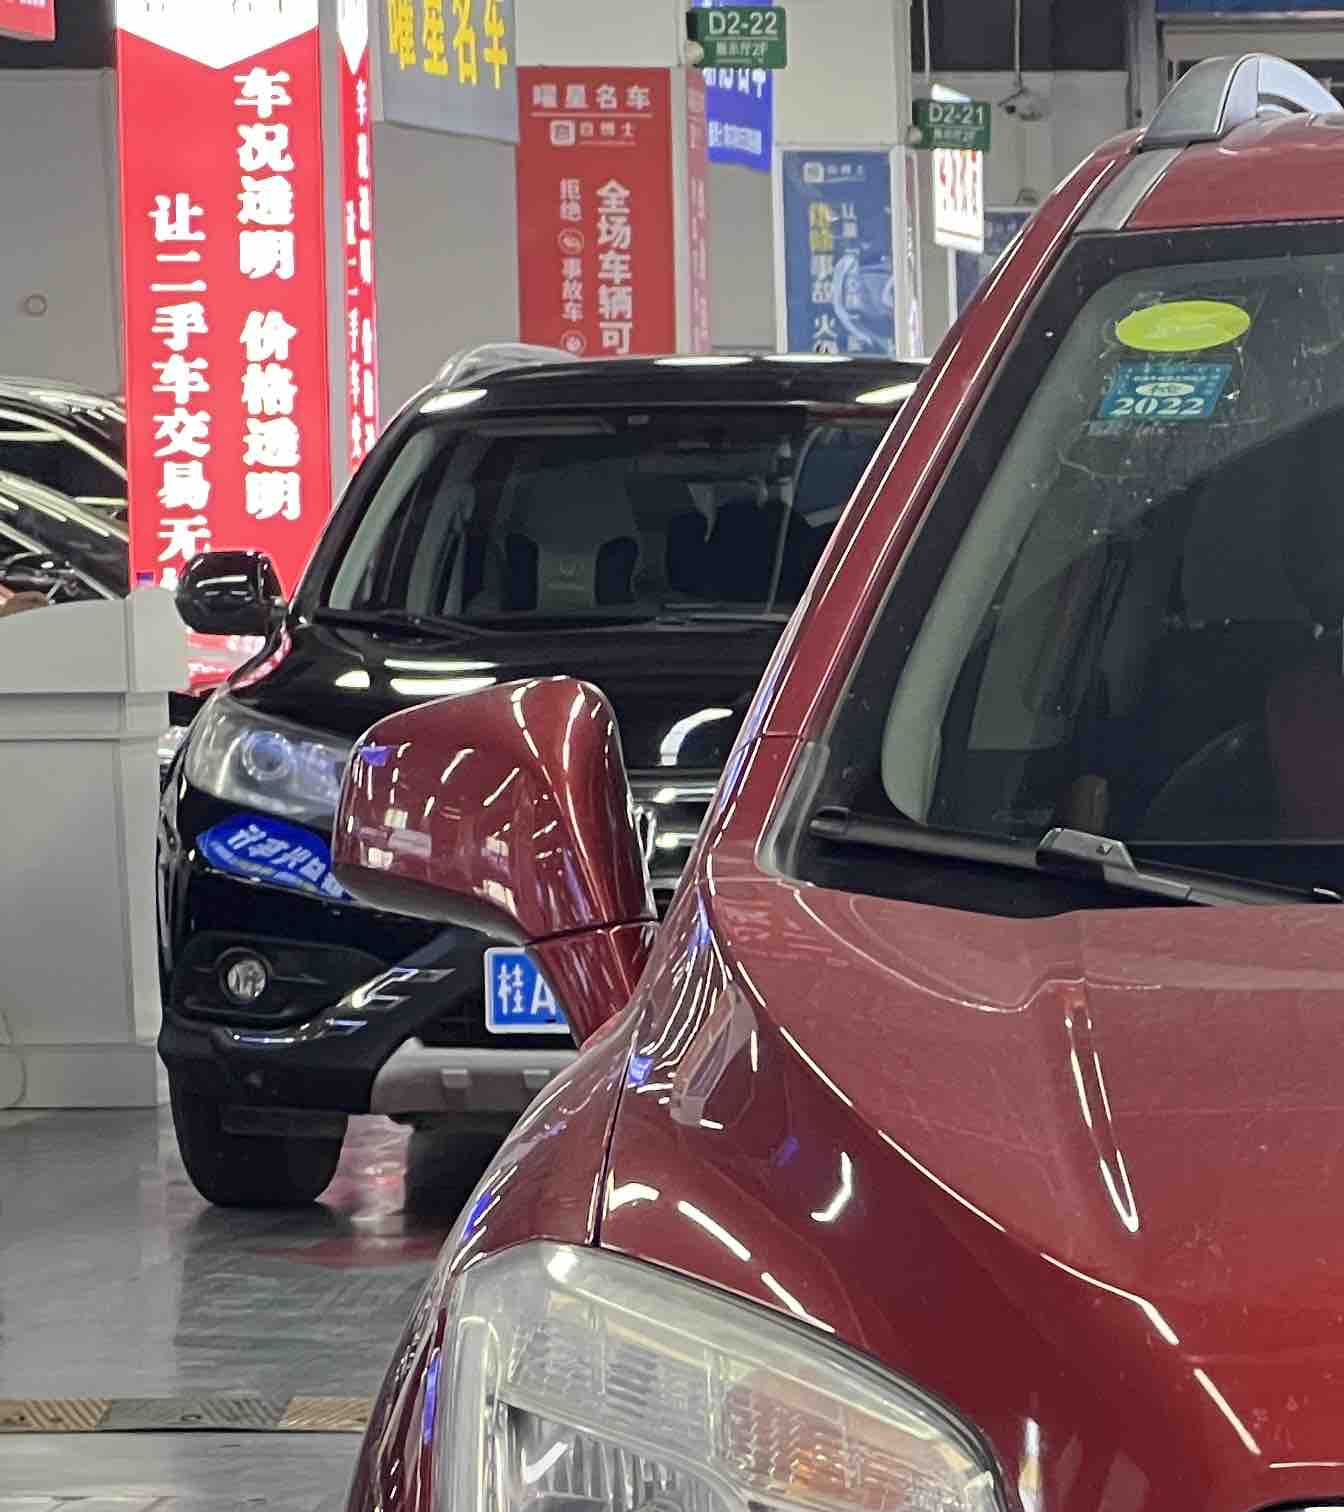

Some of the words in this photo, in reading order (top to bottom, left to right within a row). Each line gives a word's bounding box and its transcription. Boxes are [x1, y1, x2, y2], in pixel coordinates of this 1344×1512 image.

[708, 11, 778, 35] D2-22
[928, 102, 985, 124] D2-21
[233, 66, 295, 281] 车况透明
[239, 310, 301, 521] 价格透明
[1109, 397, 1205, 416] 2022
[497, 962, 557, 1016] 桂A
